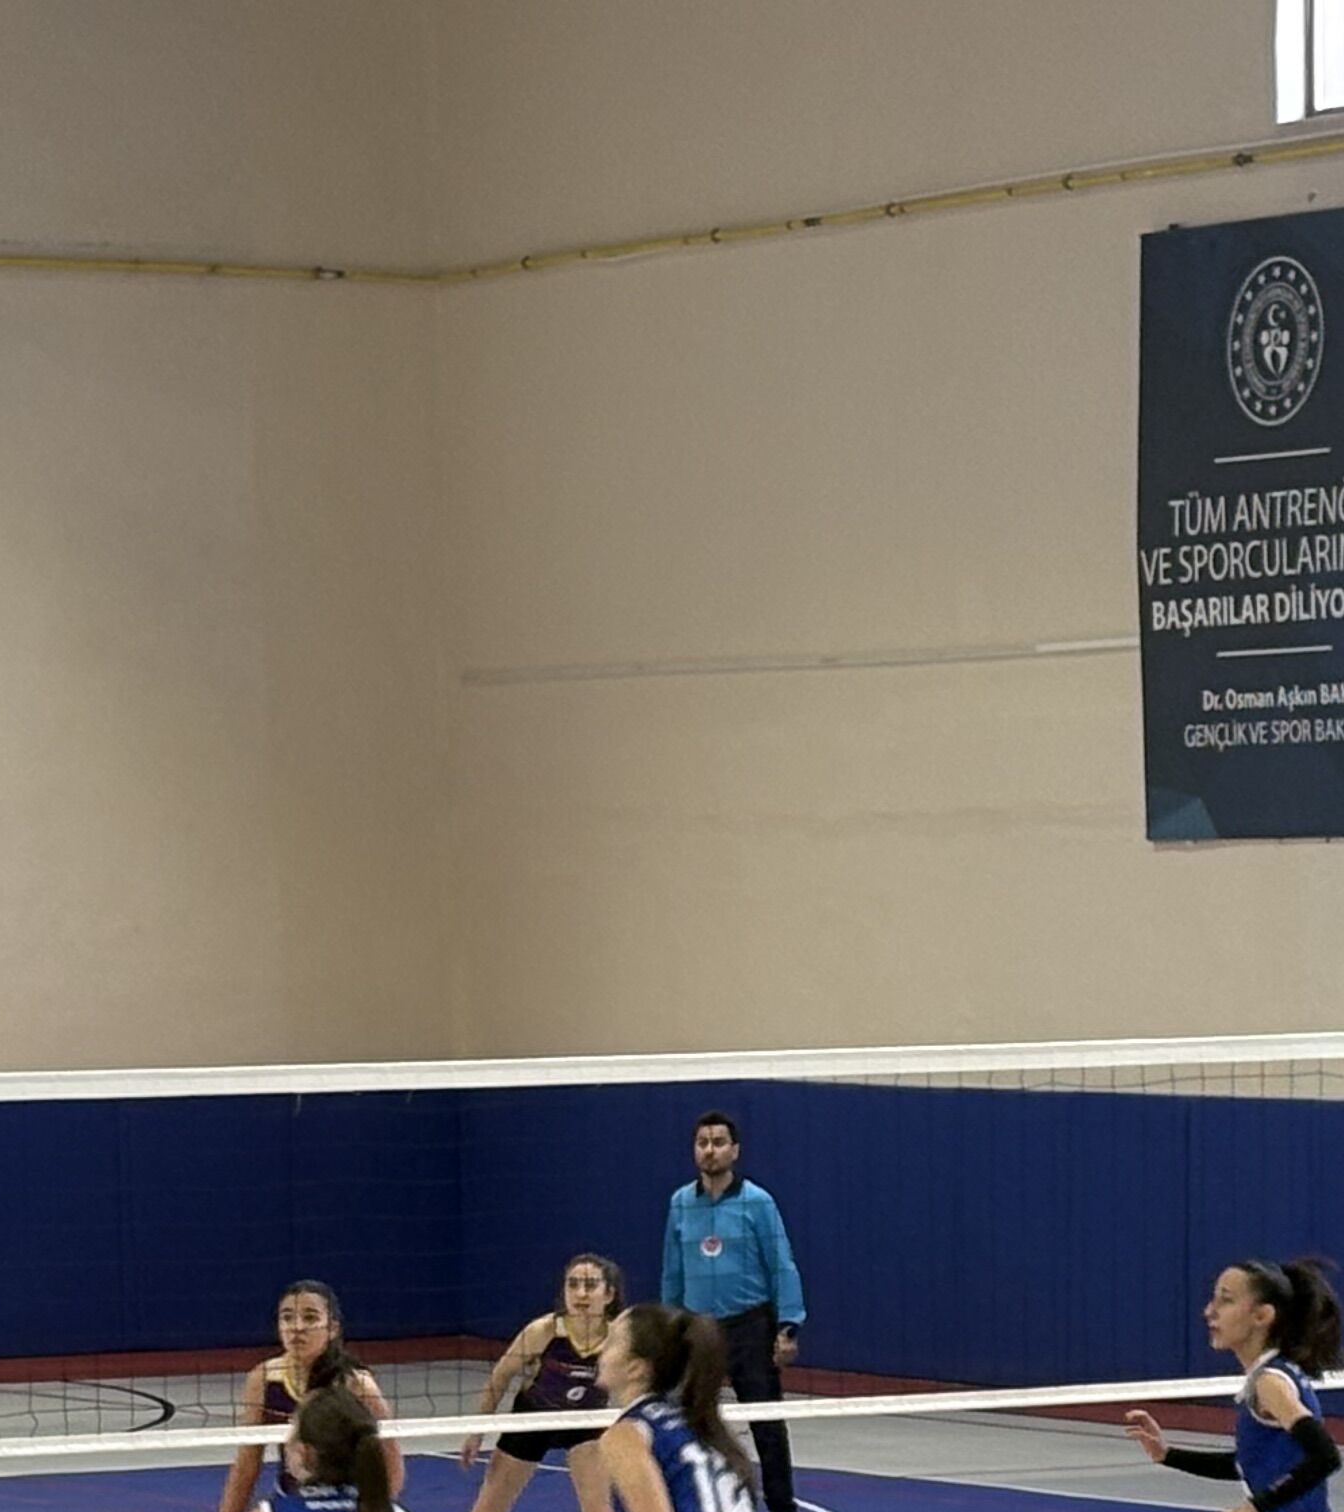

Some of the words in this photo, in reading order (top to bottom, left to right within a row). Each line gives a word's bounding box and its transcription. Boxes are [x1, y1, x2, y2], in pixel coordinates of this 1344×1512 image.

[1168, 490, 1226, 537] TÜM
[1140, 548, 1172, 587] VE
[1152, 594, 1270, 637] BAŞARILAR
[1202, 690, 1223, 712] Dr.
[1225, 689, 1274, 710] Osman
[1277, 685, 1317, 712] Aşkın
[1184, 720, 1248, 751] GENÇLİK
[1248, 721, 1269, 745] VE
[1270, 719, 1312, 744] SPOR
